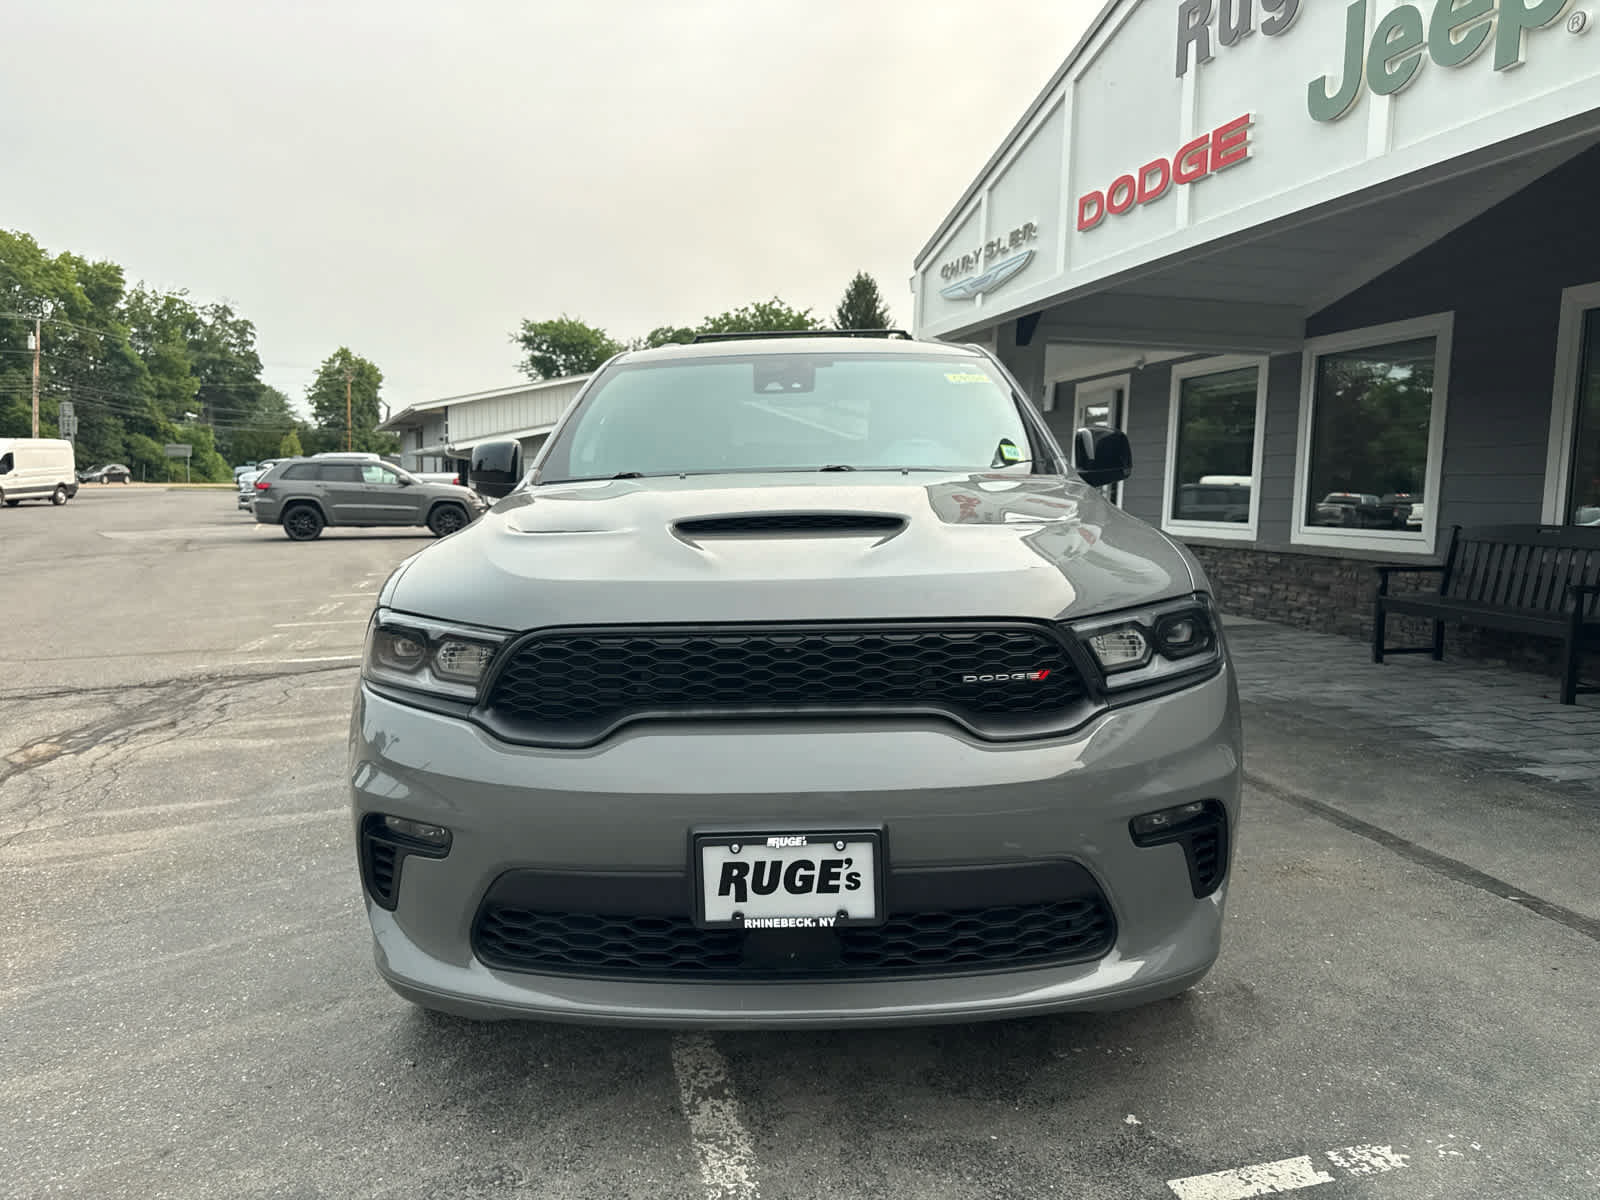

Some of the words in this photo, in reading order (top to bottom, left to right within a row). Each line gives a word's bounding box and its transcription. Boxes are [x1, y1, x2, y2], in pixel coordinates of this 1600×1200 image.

[1077, 113, 1254, 232] DODGE
[940, 222, 1037, 281] CHRYSLER
[962, 672, 1041, 682] DODGE
[718, 858, 861, 903] RUGE's
[819, 917, 836, 927] NY
